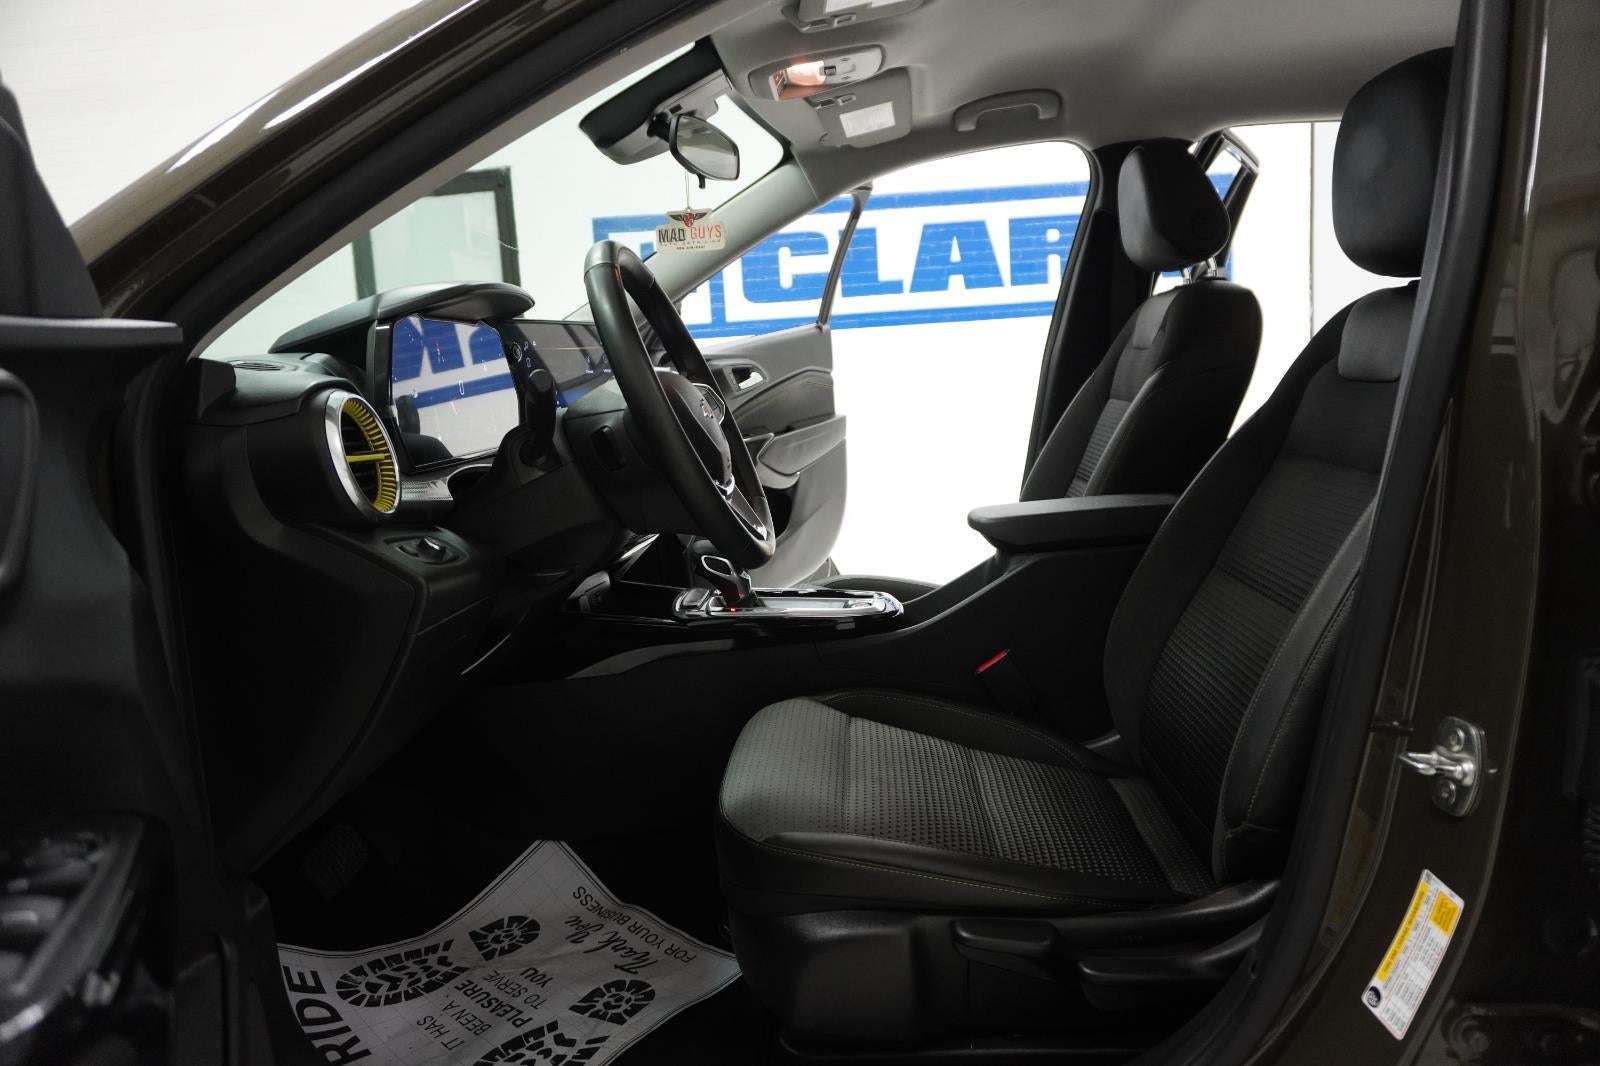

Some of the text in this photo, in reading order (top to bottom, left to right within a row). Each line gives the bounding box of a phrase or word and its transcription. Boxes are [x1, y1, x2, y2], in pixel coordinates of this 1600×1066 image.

[658, 224, 722, 243] MAD GUYS
[741, 214, 1184, 304] CLAR
[564, 915, 658, 975] Thank You
[572, 886, 697, 964] FOR YOUR BUSINESS
[482, 970, 547, 1010] TO SERVE
[519, 967, 553, 988] YOU
[282, 965, 372, 1066] RIDE
[442, 1000, 492, 1036] BEEN A
[454, 979, 533, 1028] PLEASURE
[416, 1015, 465, 1051] IT HAS
